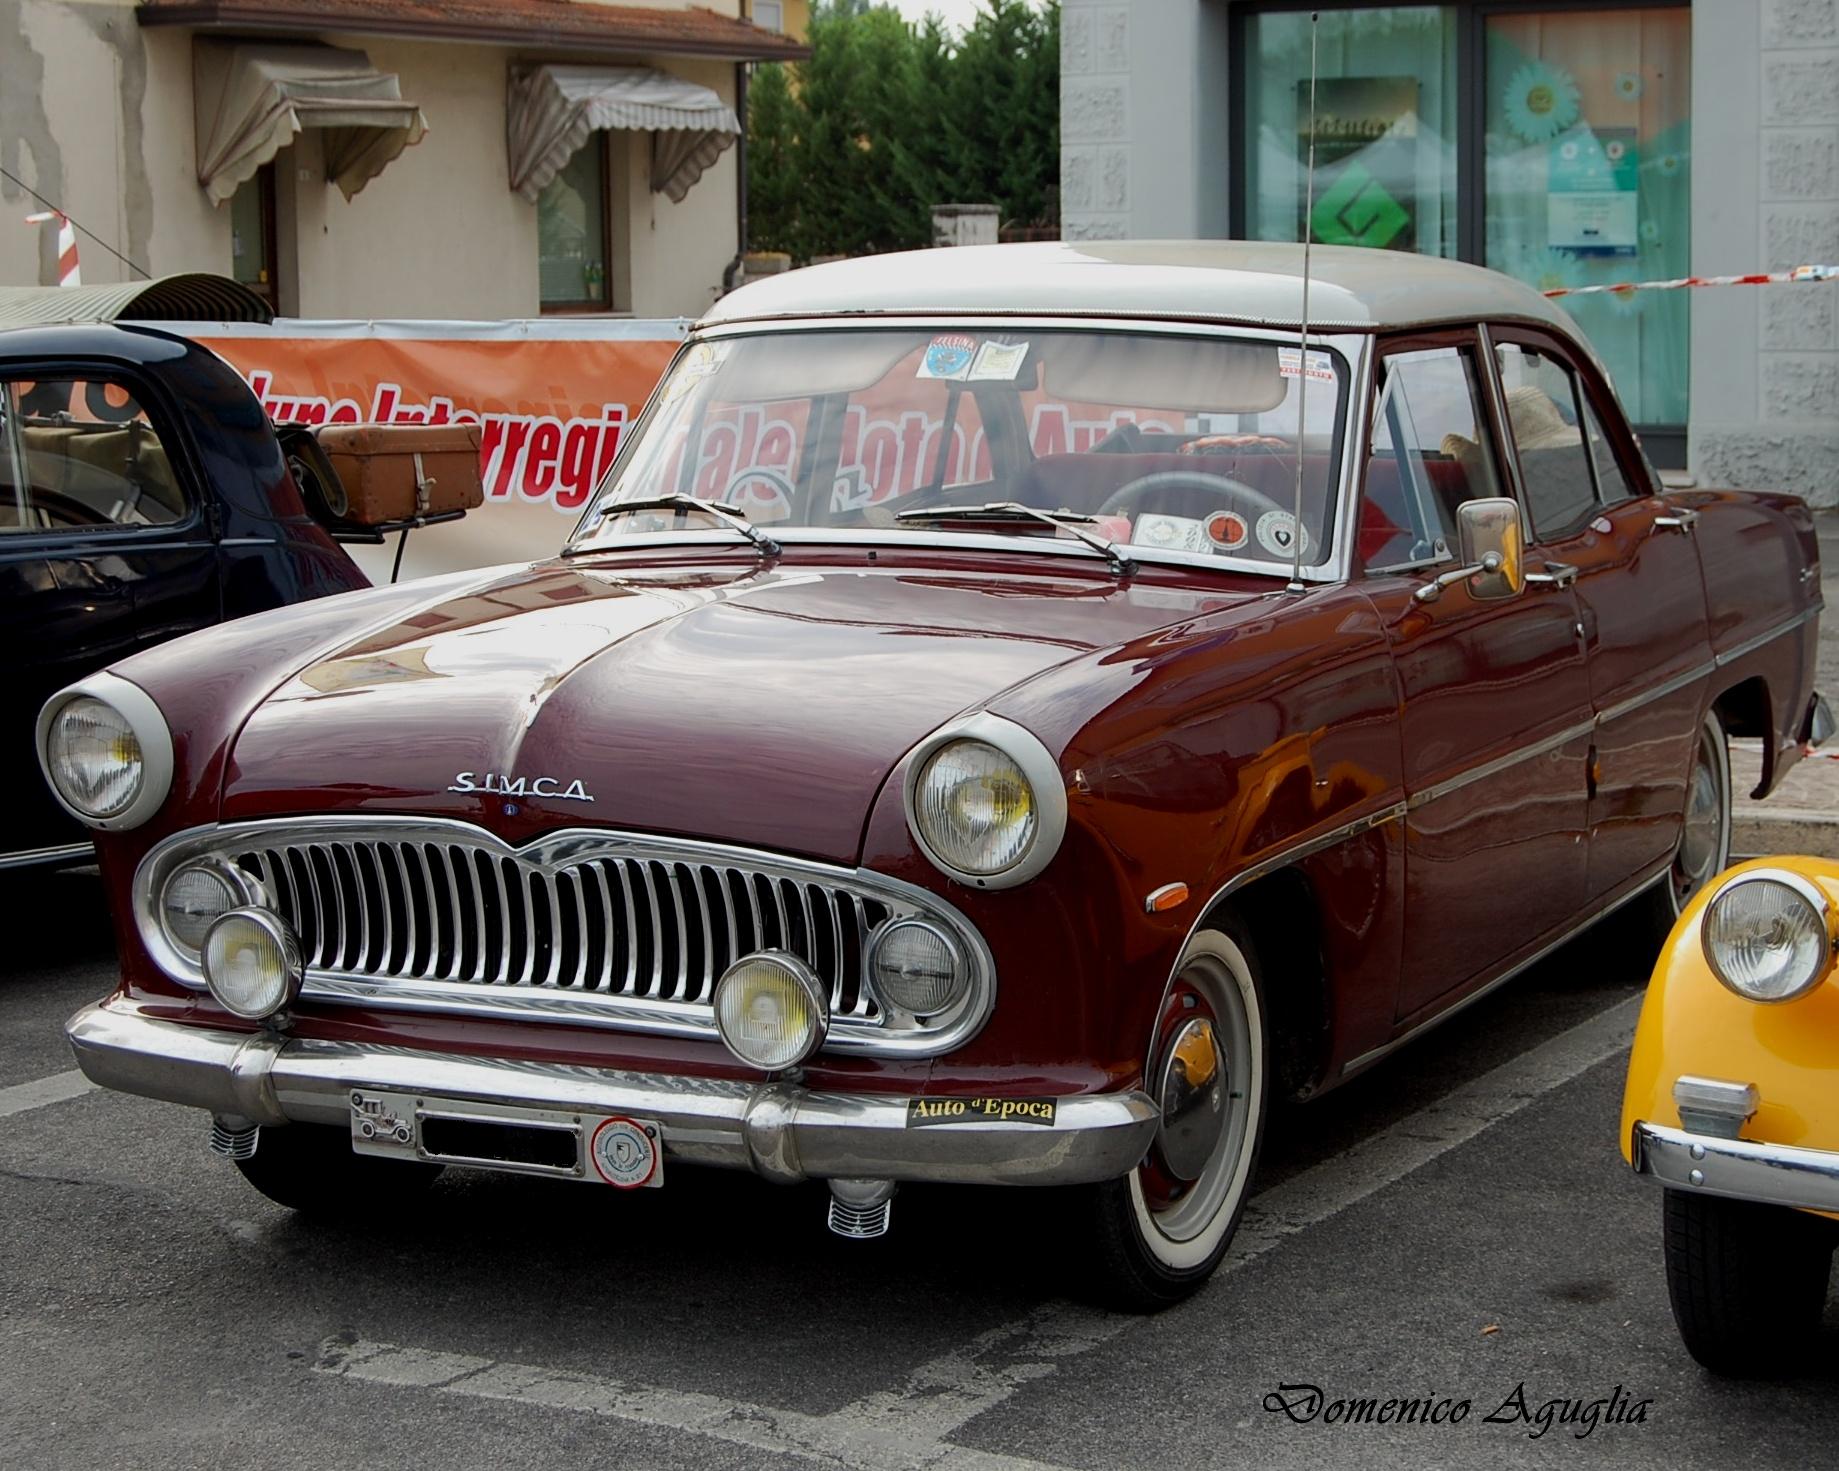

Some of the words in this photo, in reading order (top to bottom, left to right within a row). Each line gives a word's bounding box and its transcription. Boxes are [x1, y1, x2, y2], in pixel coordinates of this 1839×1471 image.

[449, 772, 594, 801] SIMCA
[911, 1100, 966, 1118] Auto
[971, 1098, 1053, 1119] d'Epoca
